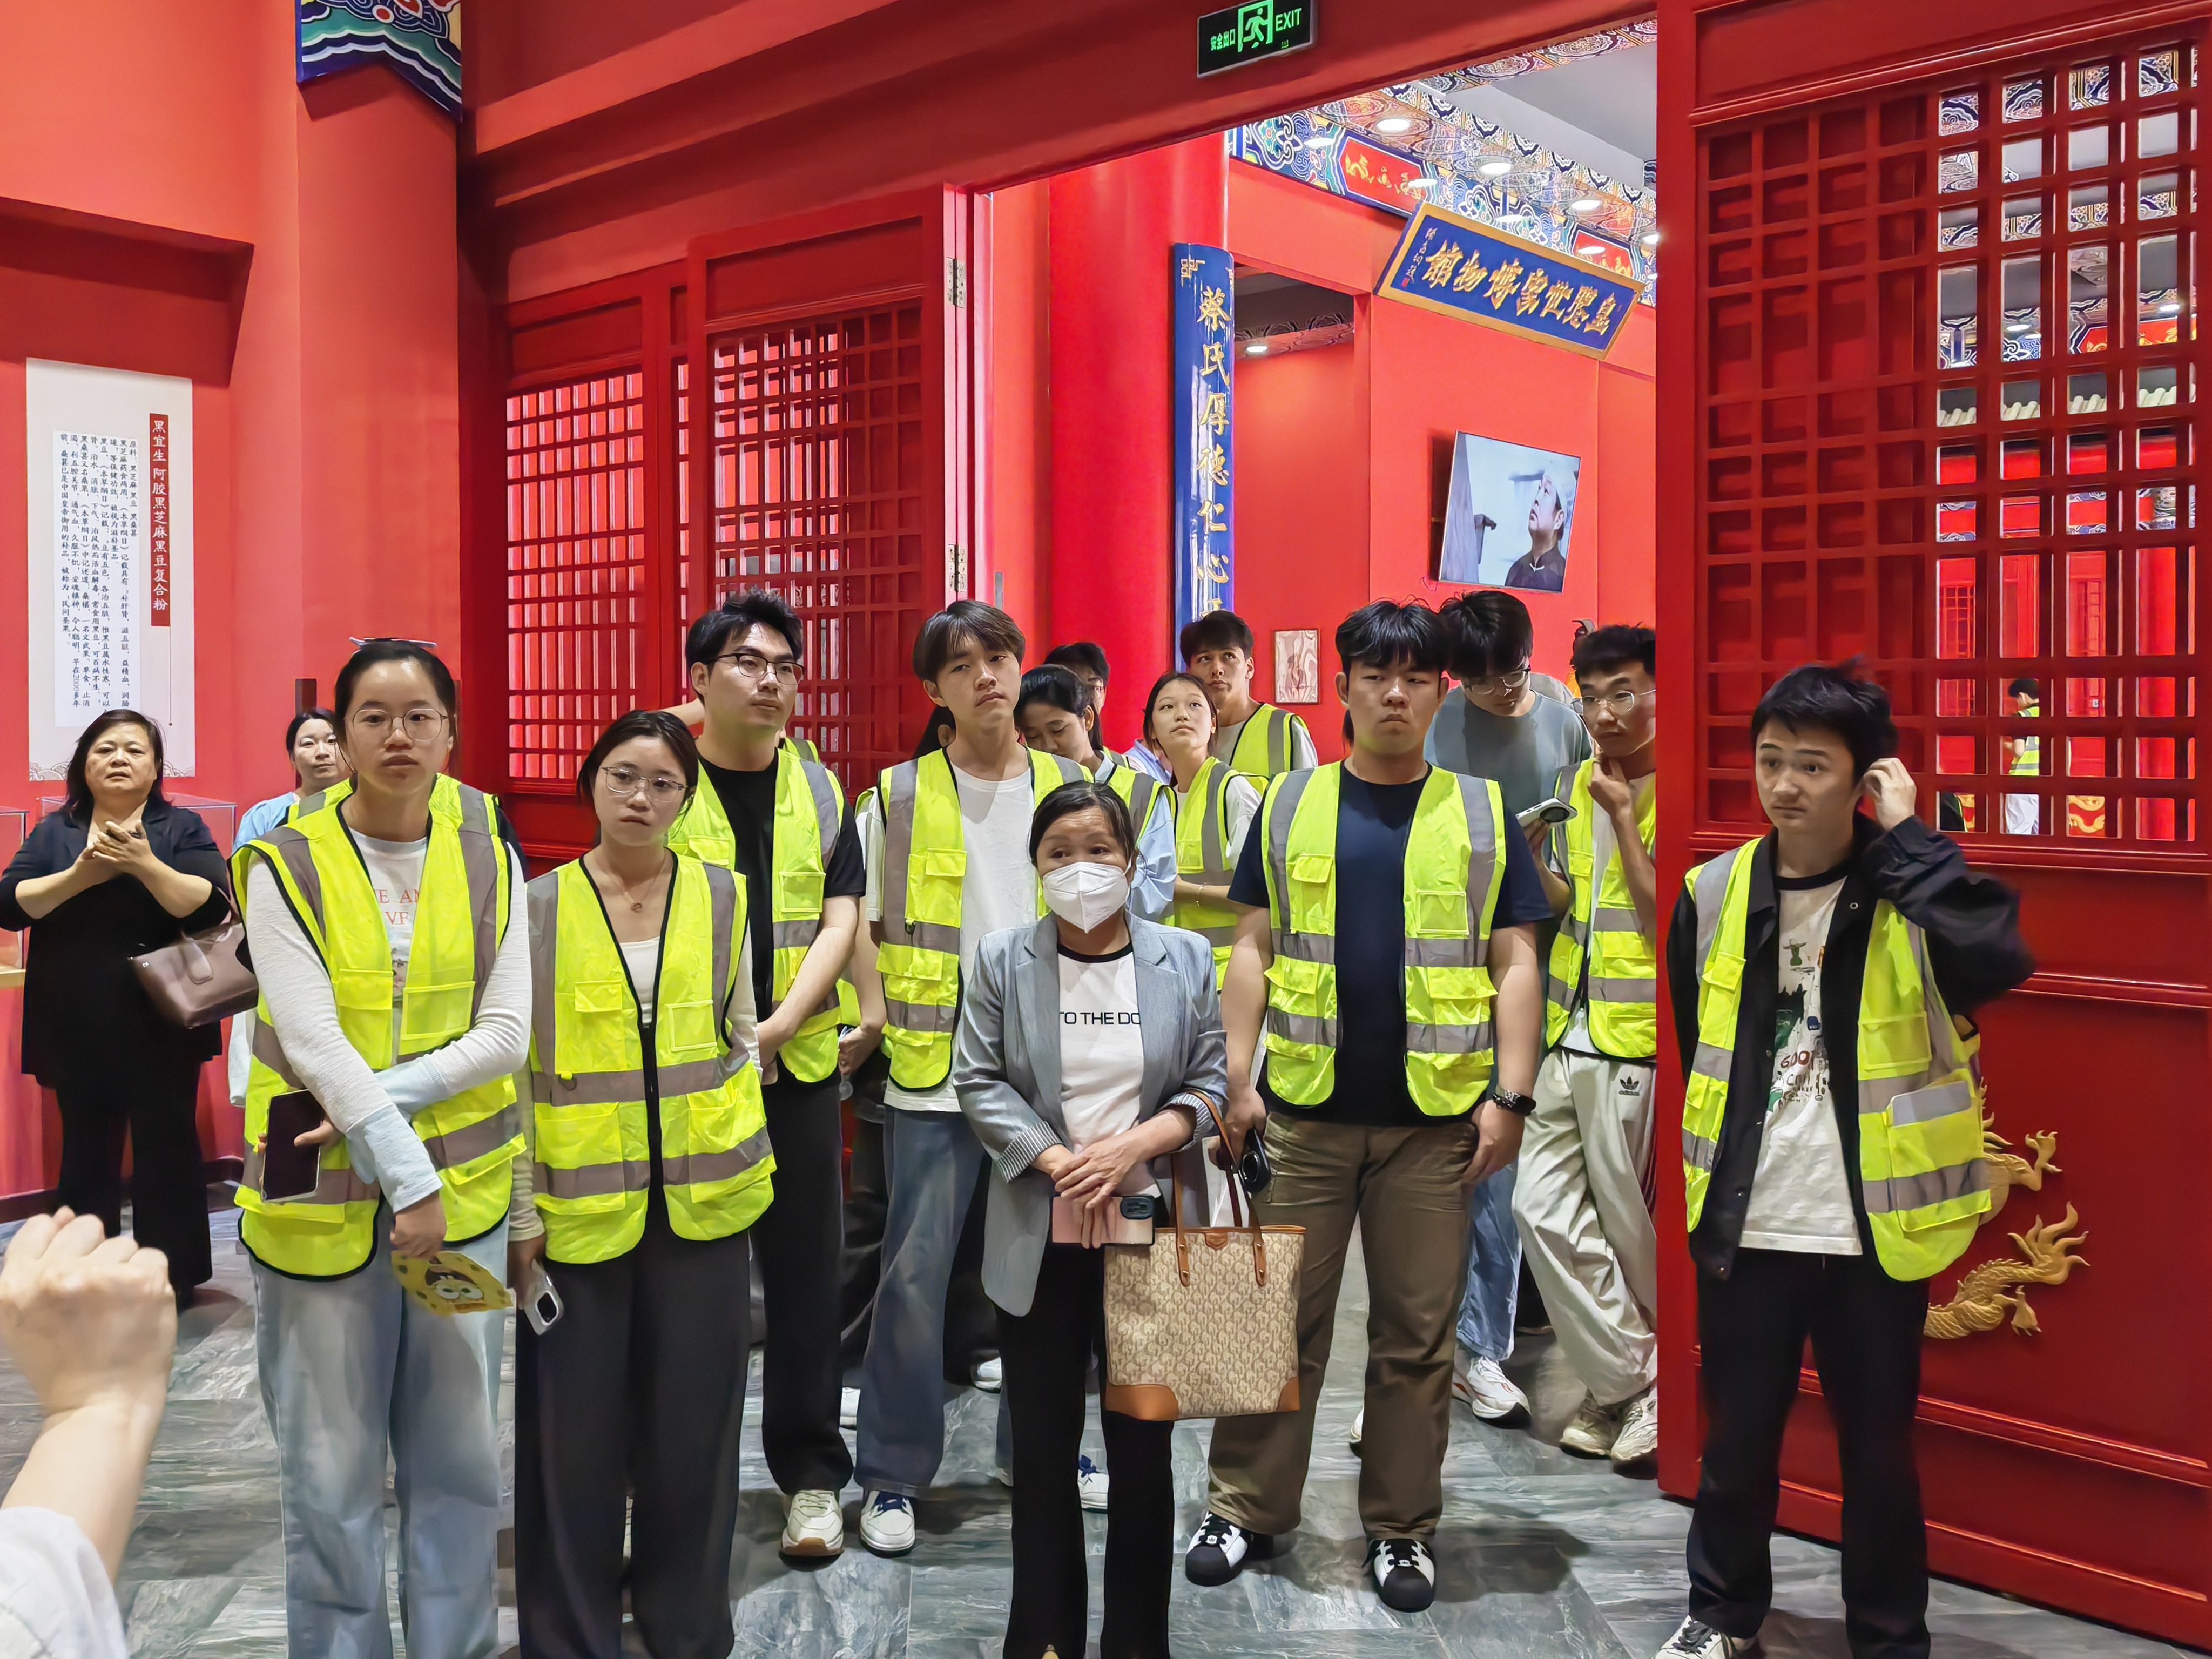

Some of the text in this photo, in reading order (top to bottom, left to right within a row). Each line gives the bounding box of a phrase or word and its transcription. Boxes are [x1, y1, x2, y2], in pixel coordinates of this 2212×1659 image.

[1276, 8, 1302, 32] EXIT
[1211, 29, 1236, 51] 安全出口
[152, 420, 168, 610] 黑宜生 阿胶黑芝麻黑豆复合粉
[1080, 1012, 1114, 1025] THE
